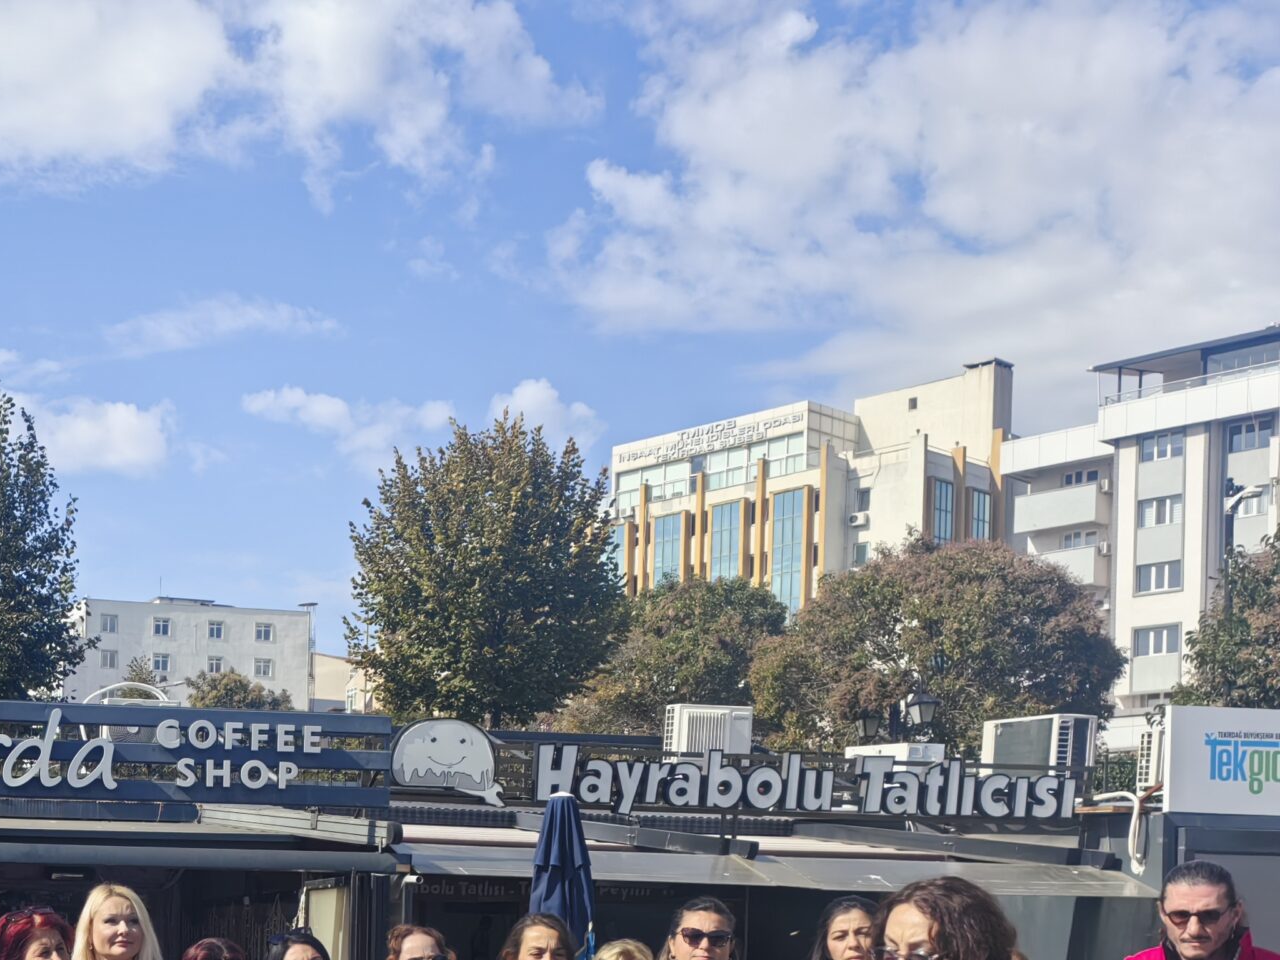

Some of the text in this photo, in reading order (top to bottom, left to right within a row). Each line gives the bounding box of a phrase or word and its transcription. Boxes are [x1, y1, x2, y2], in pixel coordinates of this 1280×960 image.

[677, 420, 737, 441] TMMOB
[155, 718, 322, 753] COFFEE
[177, 758, 299, 790] SHOP
[535, 743, 835, 815] Hayrabolu
